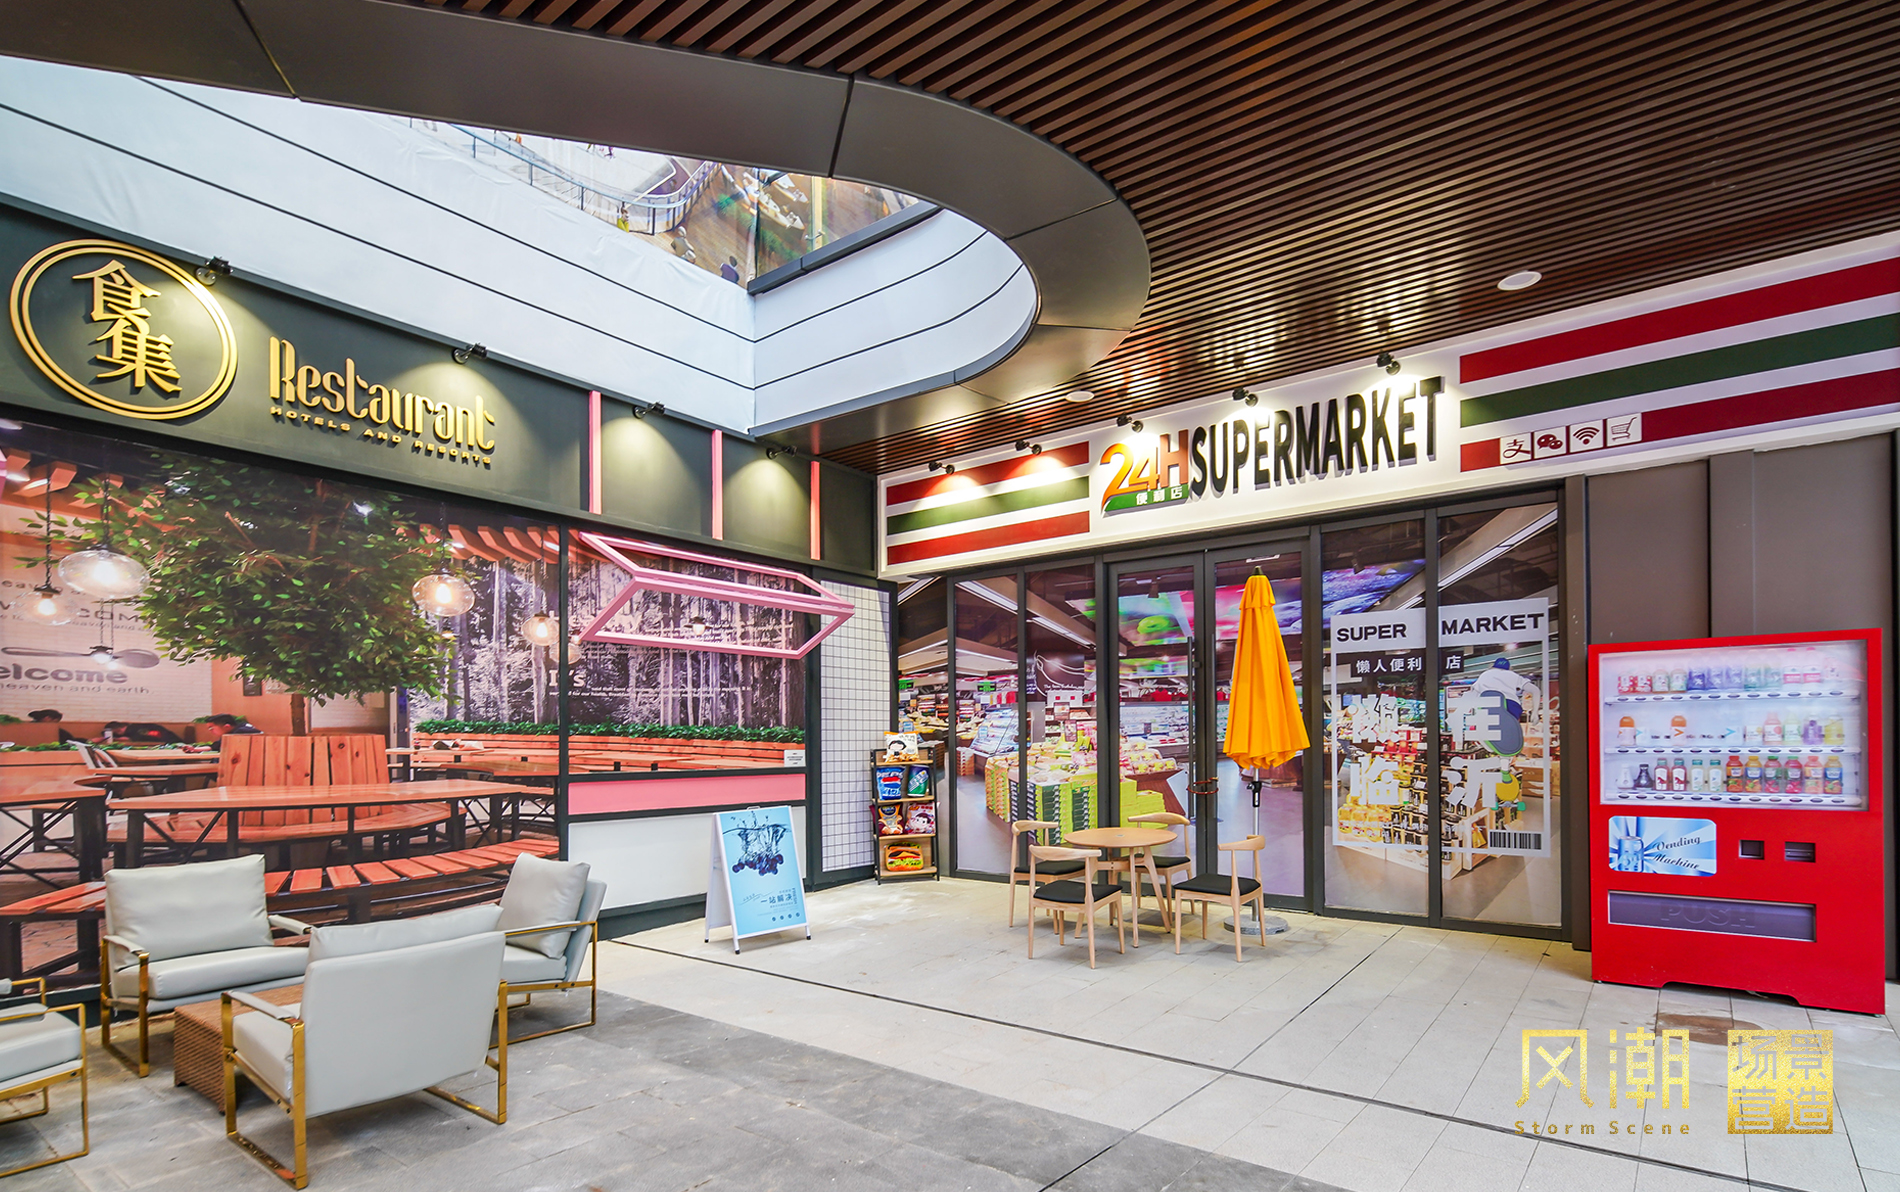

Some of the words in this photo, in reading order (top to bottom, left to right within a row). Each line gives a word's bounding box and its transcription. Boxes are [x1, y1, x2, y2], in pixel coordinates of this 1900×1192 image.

[73, 259, 182, 392] 食集
[269, 336, 495, 451] Restaurant
[270, 407, 350, 431] HOTELS
[364, 428, 402, 443] AND
[414, 440, 491, 464] RESORTS
[1100, 429, 1189, 512] 24H
[1191, 376, 1444, 498] SUPERMARKET
[1136, 485, 1183, 505] 便利店
[1336, 622, 1408, 642] SUPER
[1441, 613, 1545, 635] MARKET
[1653, 835, 1700, 851] Vending
[1653, 853, 1700, 870] Machine
[1660, 904, 1755, 929] PUSH
